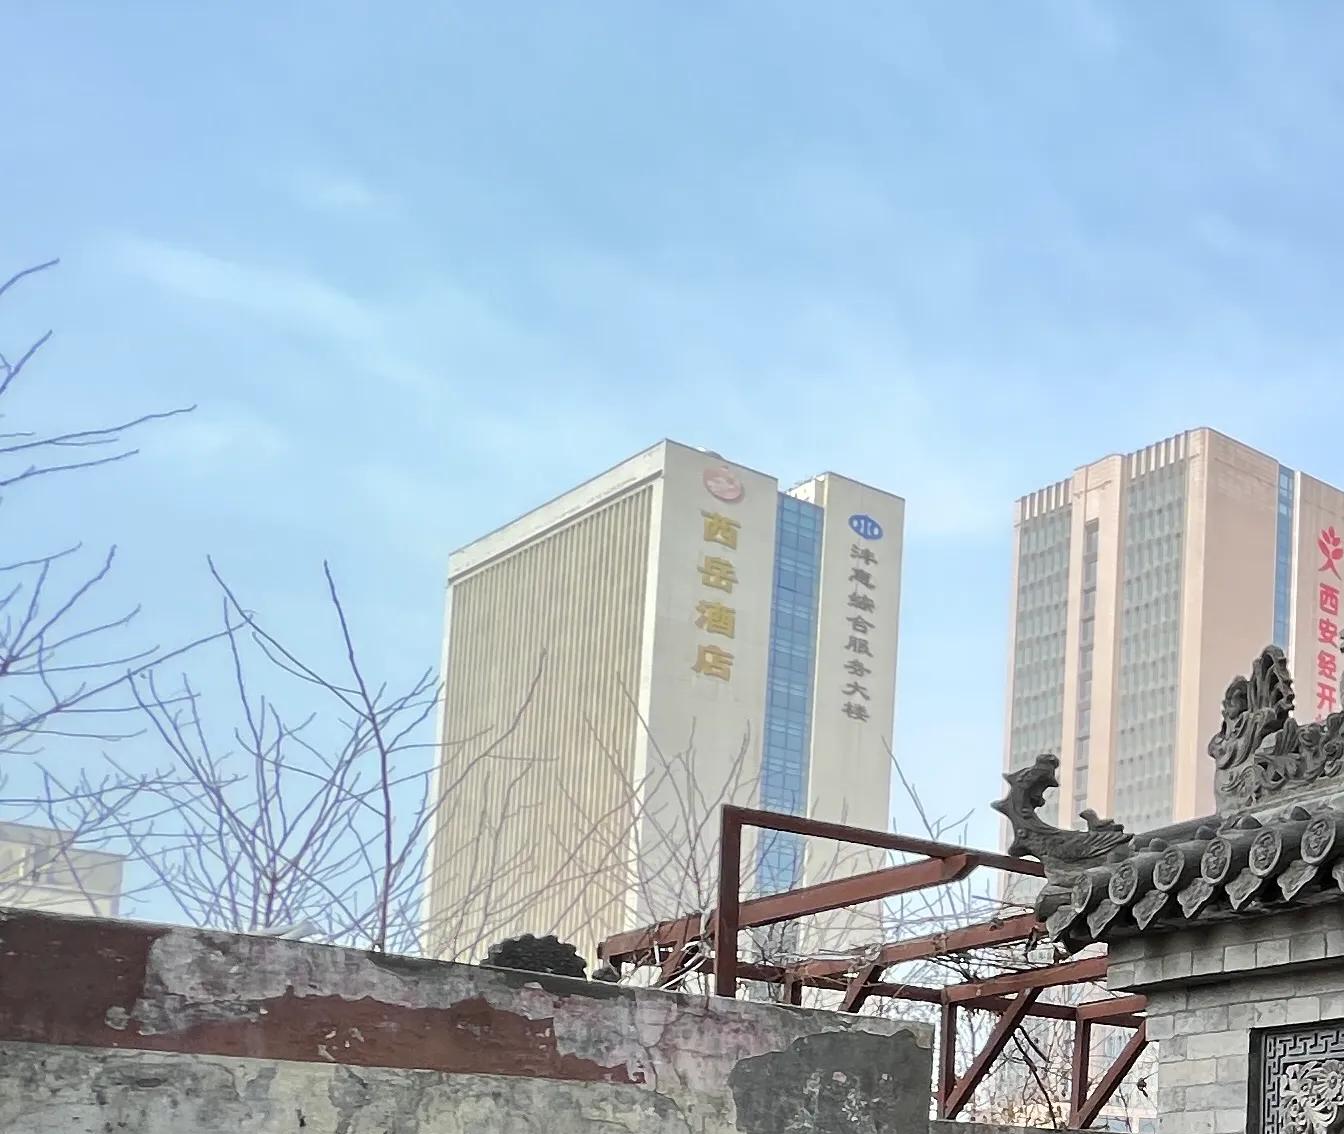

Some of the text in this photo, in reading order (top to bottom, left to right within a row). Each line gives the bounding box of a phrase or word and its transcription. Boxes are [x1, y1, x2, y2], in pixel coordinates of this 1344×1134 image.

[692, 508, 741, 682] 西岳酒店
[1316, 582, 1340, 724] 西安经开
